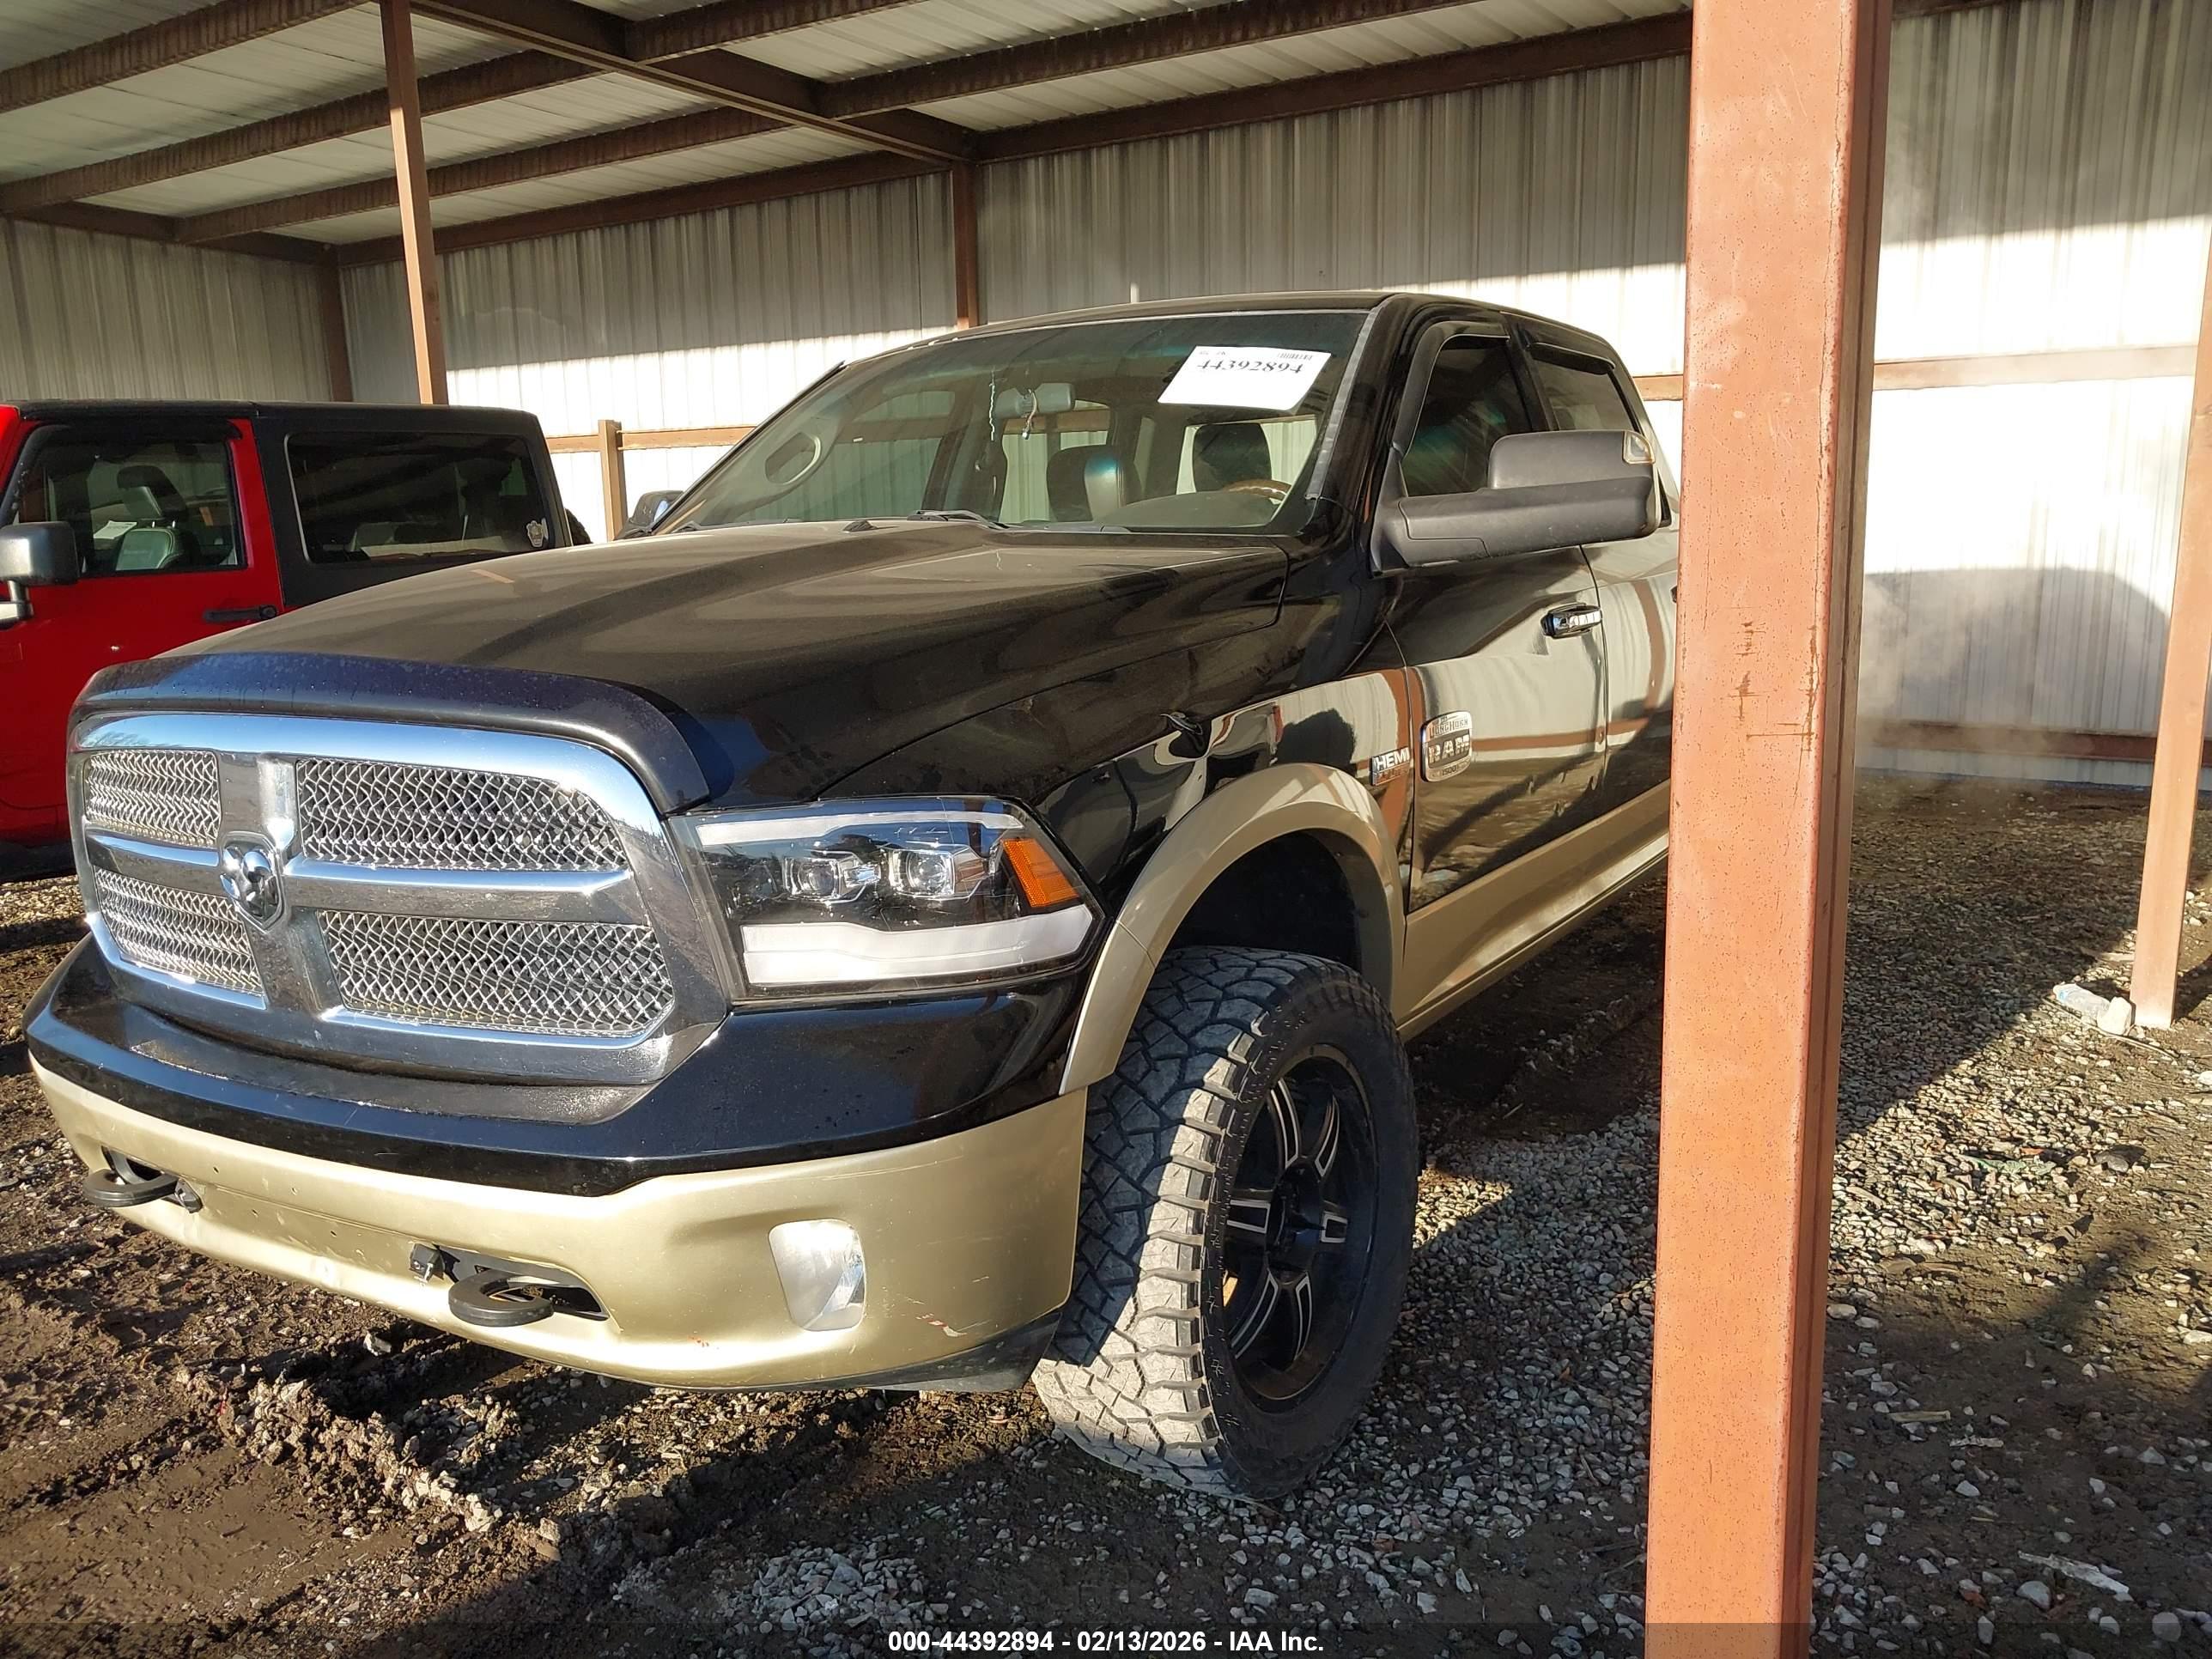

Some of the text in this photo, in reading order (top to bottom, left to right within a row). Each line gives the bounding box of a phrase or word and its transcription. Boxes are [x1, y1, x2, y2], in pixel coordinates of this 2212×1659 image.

[1197, 359, 1304, 374] 44392894
[1375, 747, 1411, 771] HEMI
[1429, 735, 1470, 764] RAM
